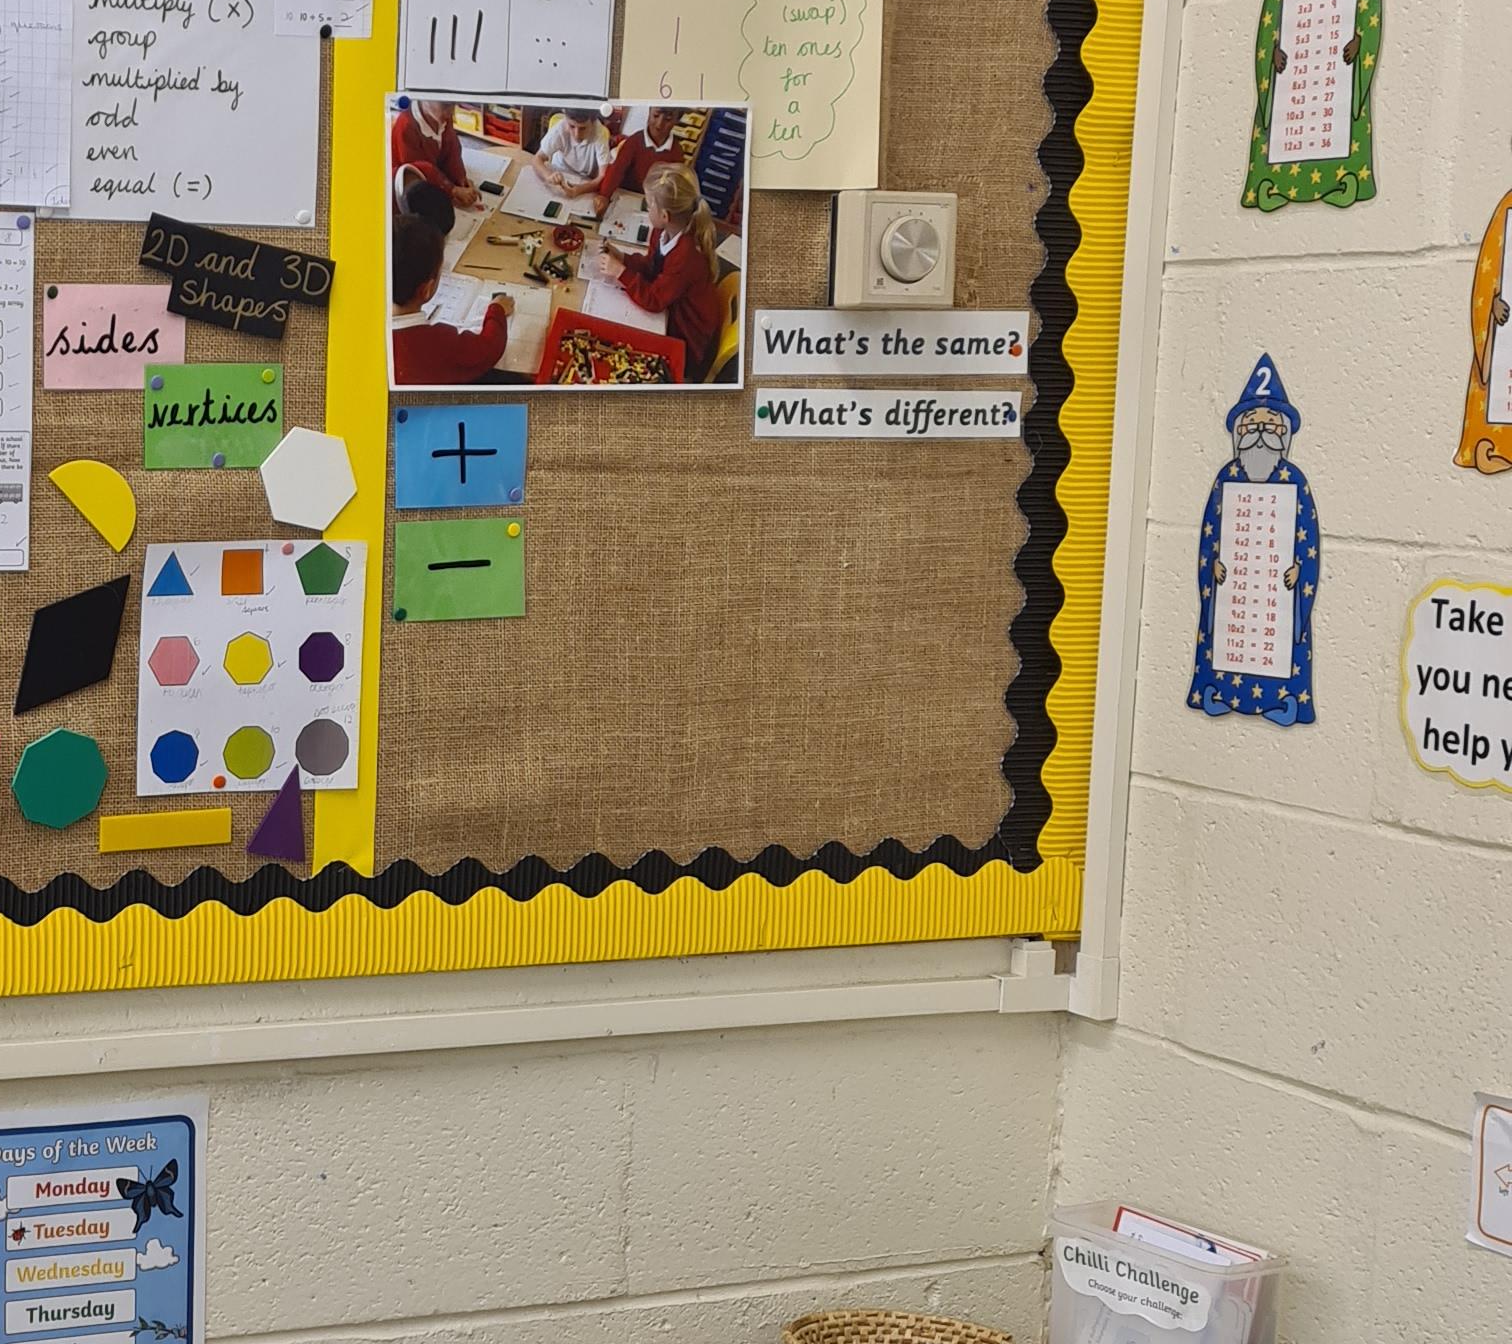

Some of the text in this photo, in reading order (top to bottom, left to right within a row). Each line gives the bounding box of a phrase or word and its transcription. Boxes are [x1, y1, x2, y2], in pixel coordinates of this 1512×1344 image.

[782, 2, 846, 27] (swap)
[87, 30, 156, 58] group
[90, 174, 156, 197] equal
[142, 228, 331, 295] 2D and 3D
[180, 278, 287, 330] shapes
[47, 314, 160, 356] sides
[765, 328, 1019, 355] What's the same?
[148, 388, 277, 429] vertices
[767, 398, 1013, 434] What's different?
[1431, 598, 1504, 636] Take
[1417, 664, 1470, 695] you
[1424, 718, 1489, 766] help
[40, 1142, 63, 1160] of
[68, 1138, 100, 1157] the
[104, 1132, 158, 1154] Week
[35, 1175, 111, 1202] Monday
[34, 1218, 110, 1242] Tuesday
[17, 1258, 125, 1283] Wednesday
[1064, 1245, 1199, 1305] Chilli Challenge
[1088, 1278, 1116, 1297] Choose
[1118, 1290, 1137, 1303] your
[26, 1301, 115, 1325] Thursday
